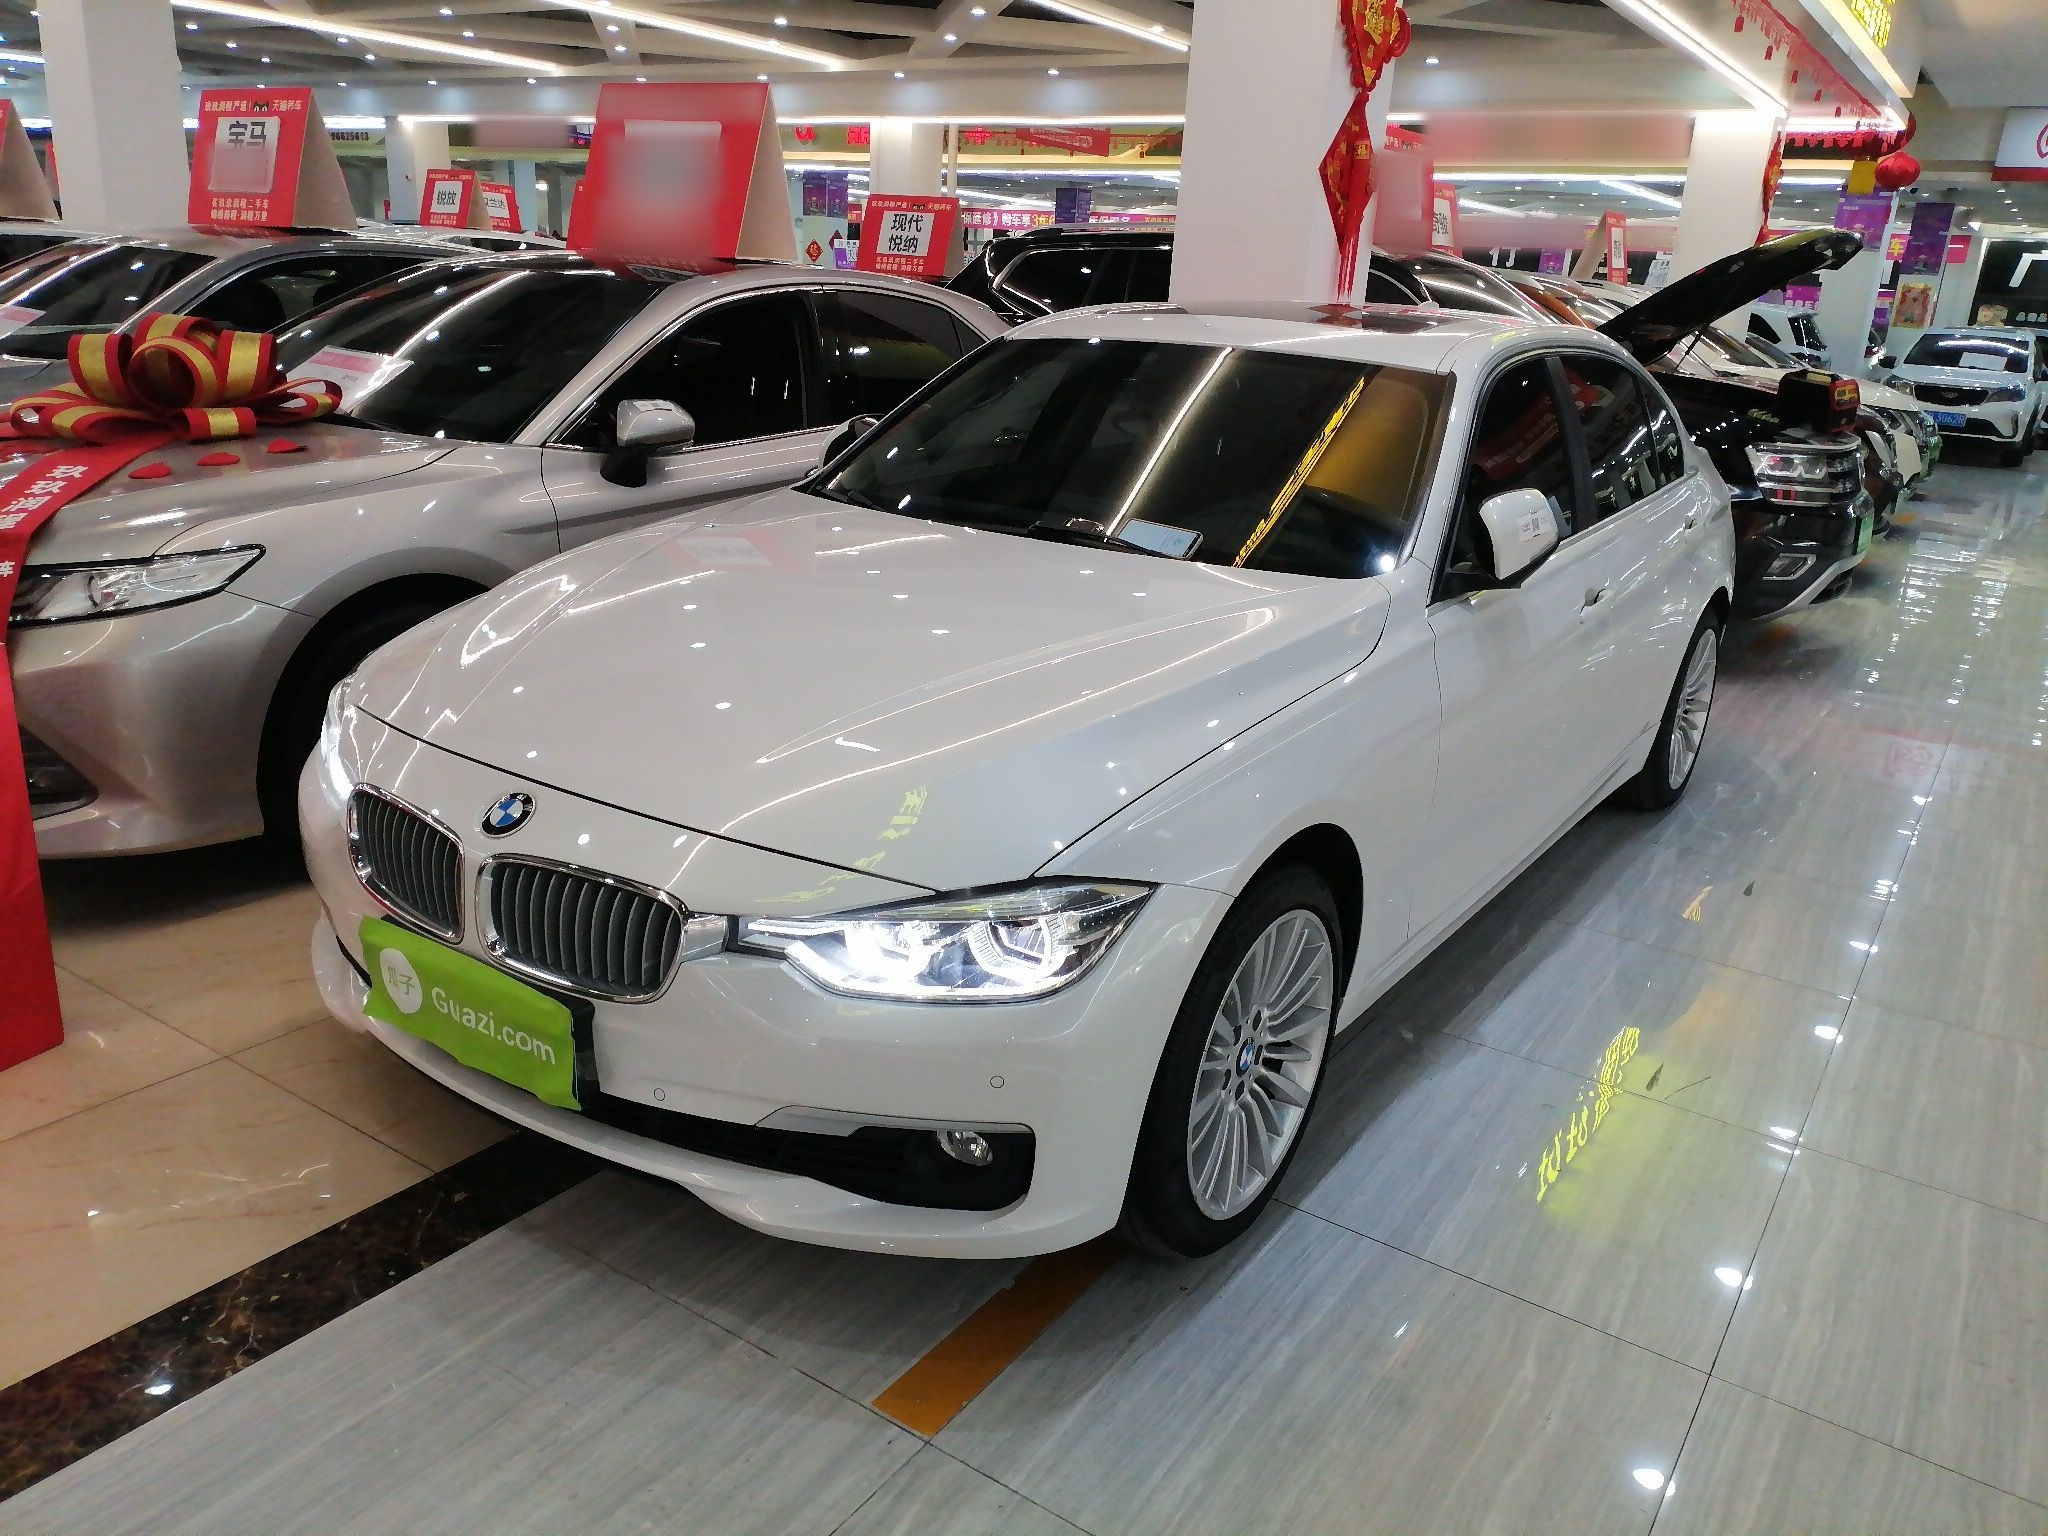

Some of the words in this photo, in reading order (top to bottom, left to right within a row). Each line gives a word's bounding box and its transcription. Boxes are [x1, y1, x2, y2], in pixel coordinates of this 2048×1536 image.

[228, 121, 267, 149] 宝马
[436, 190, 457, 206] 锐放
[890, 213, 924, 233] 现代
[888, 233, 919, 254] 悦纳
[431, 986, 557, 1066] Guazi.com
